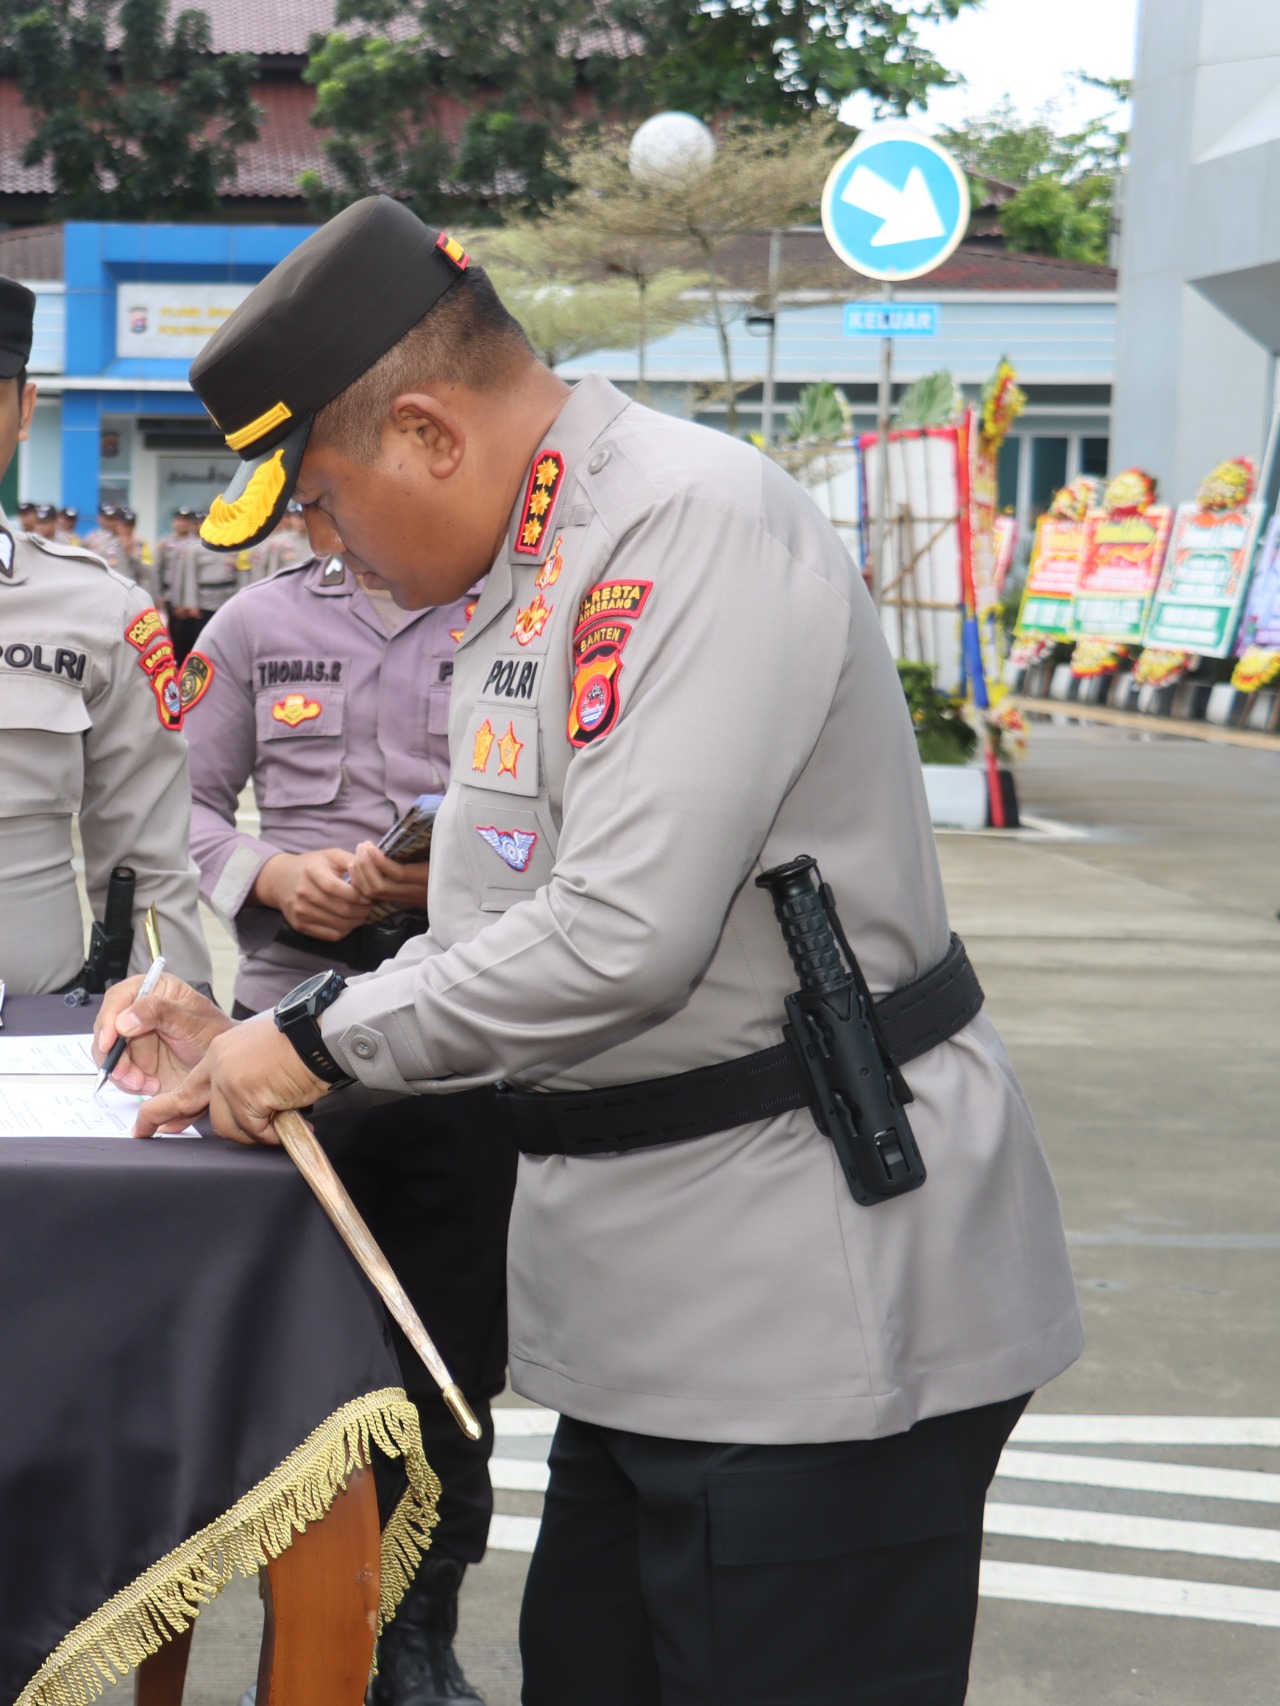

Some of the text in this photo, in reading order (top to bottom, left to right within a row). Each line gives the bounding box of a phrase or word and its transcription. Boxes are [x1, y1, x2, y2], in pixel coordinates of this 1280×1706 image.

[849, 312, 932, 330] KELUAR
[580, 585, 640, 610] LRESTA
[579, 598, 632, 624] ANGERANG
[580, 627, 621, 653] BANTEN
[257, 660, 342, 686] THOMAS.R
[481, 660, 539, 700] POLRI
